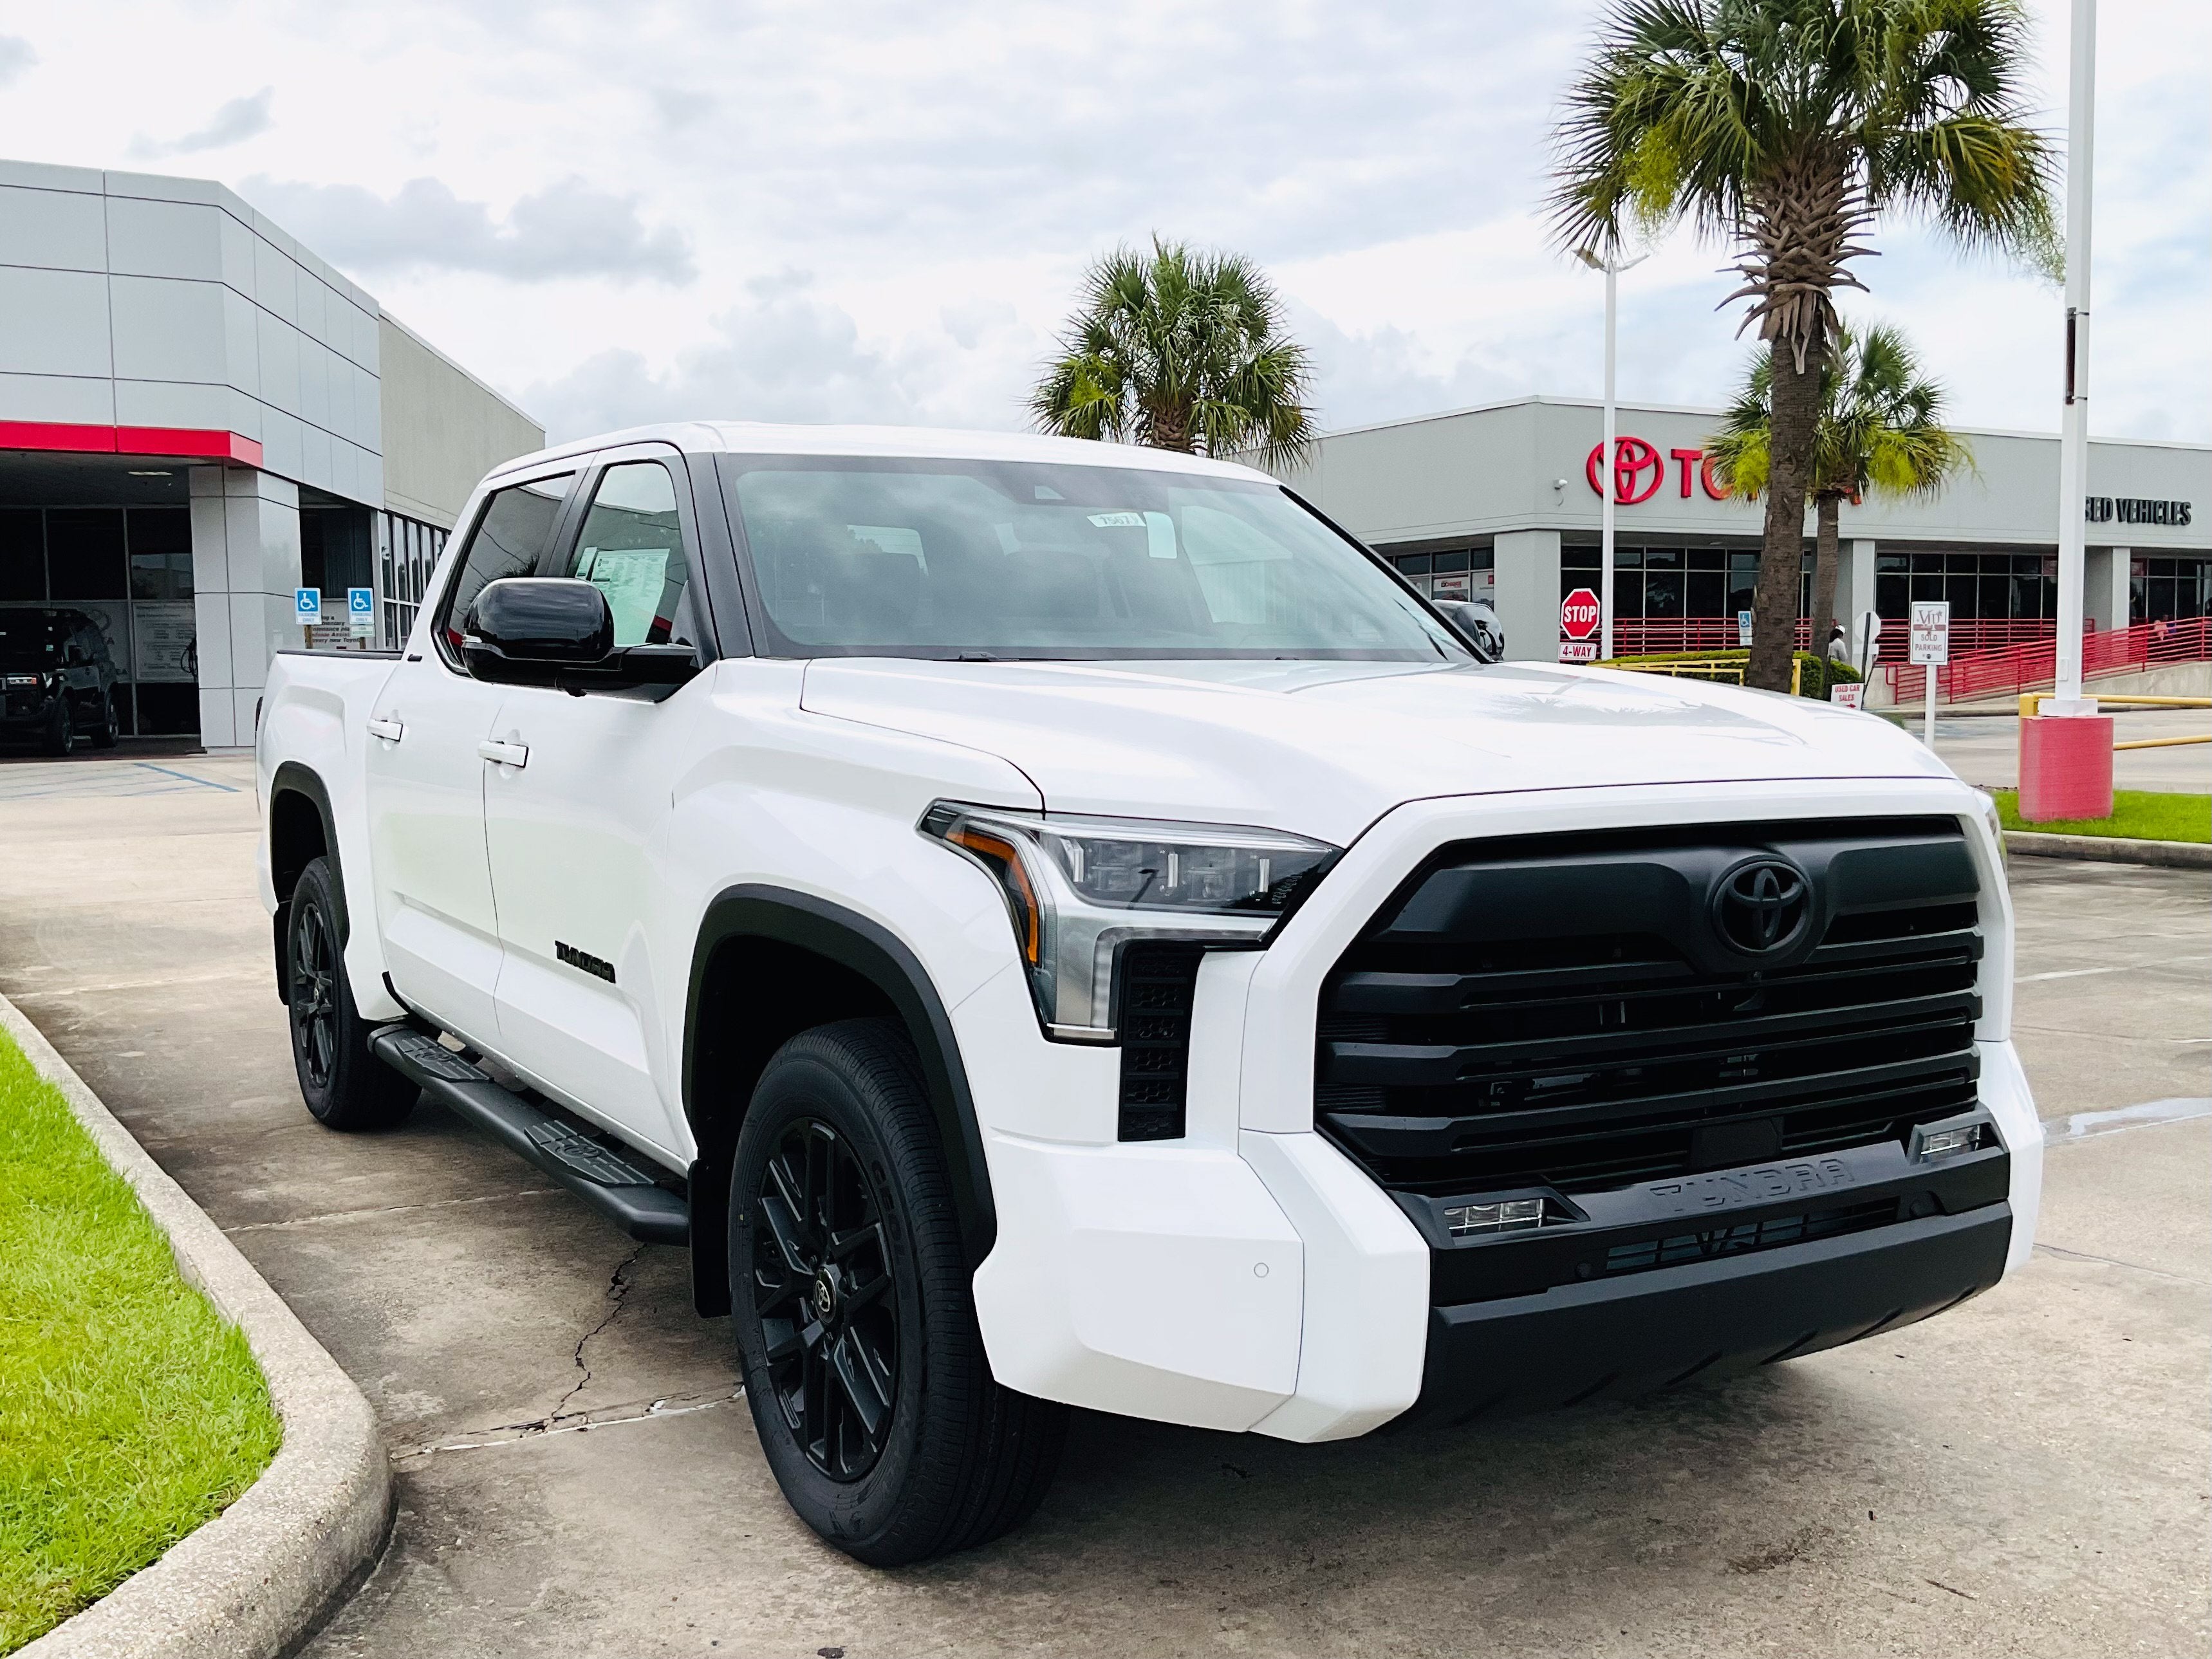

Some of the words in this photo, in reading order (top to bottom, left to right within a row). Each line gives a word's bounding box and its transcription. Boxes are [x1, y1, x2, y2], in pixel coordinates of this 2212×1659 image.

[2085, 496, 2113, 522] SED
[2115, 498, 2191, 526] VEHICLES
[1564, 605, 1597, 622] STOP
[1920, 633, 1937, 642] SOLD
[1563, 645, 1592, 657] 4-WAY
[1650, 1158, 1855, 1212] TUNDRA
